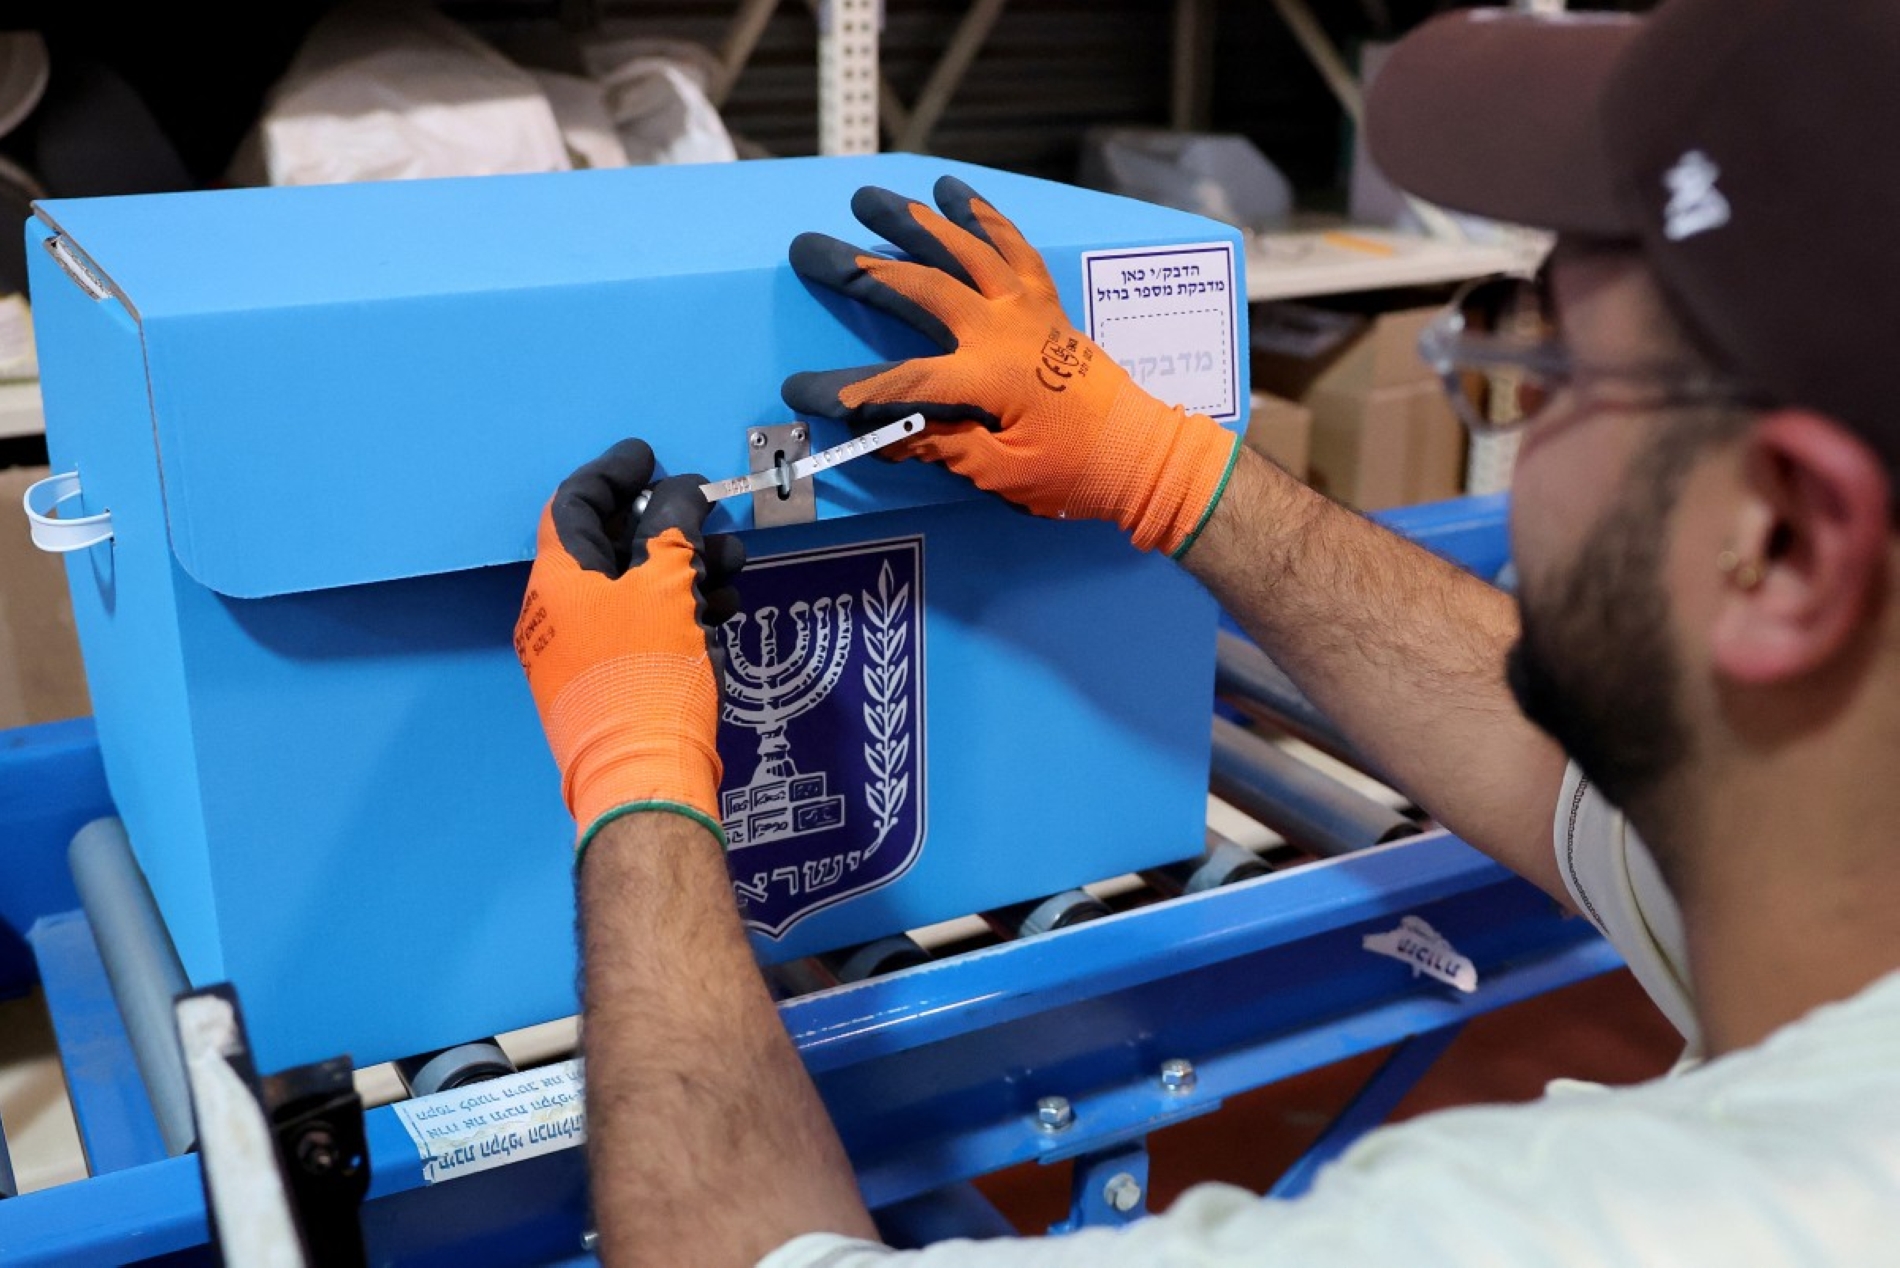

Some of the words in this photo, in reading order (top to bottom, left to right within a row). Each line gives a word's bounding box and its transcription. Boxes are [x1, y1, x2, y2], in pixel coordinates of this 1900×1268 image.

[1121, 268, 1146, 284] כאן
[1150, 265, 1200, 282] הדבק/י
[1097, 288, 1130, 302] ברזל
[1134, 285, 1173, 299] מספר
[1177, 280, 1225, 296] מדבקת
[733, 850, 862, 907] ישרא
[459, 1092, 500, 1114] לסגור
[502, 1081, 540, 1098] היטב
[541, 1075, 565, 1089] את
[463, 1115, 488, 1130] את
[489, 1104, 529, 1122] תיבת
[479, 1134, 524, 1160] הקלפי
